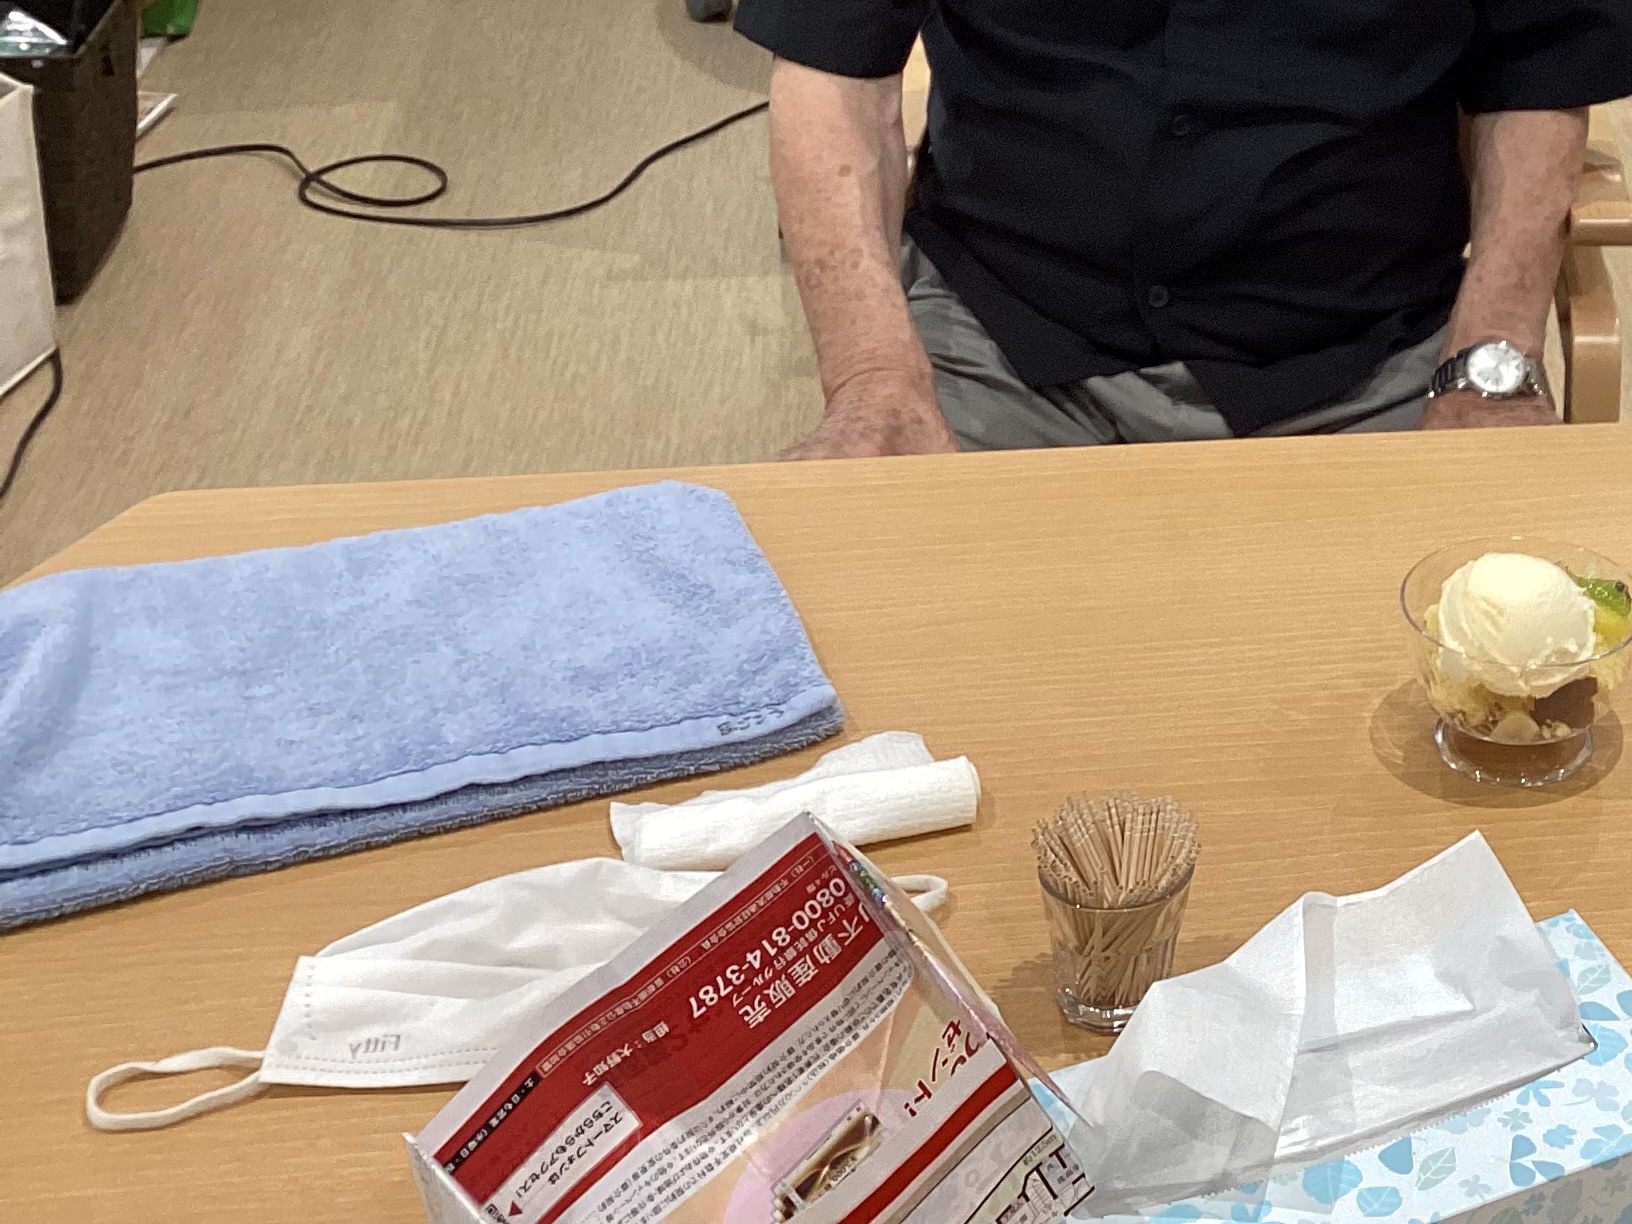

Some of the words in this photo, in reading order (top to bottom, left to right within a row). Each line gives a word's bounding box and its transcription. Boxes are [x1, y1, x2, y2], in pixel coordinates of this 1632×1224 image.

[682, 875, 848, 1019] 0800-814-3787
[513, 1099, 613, 1198] こちらからもアクセス！
[546, 1111, 623, 1186] スマートフォンは
